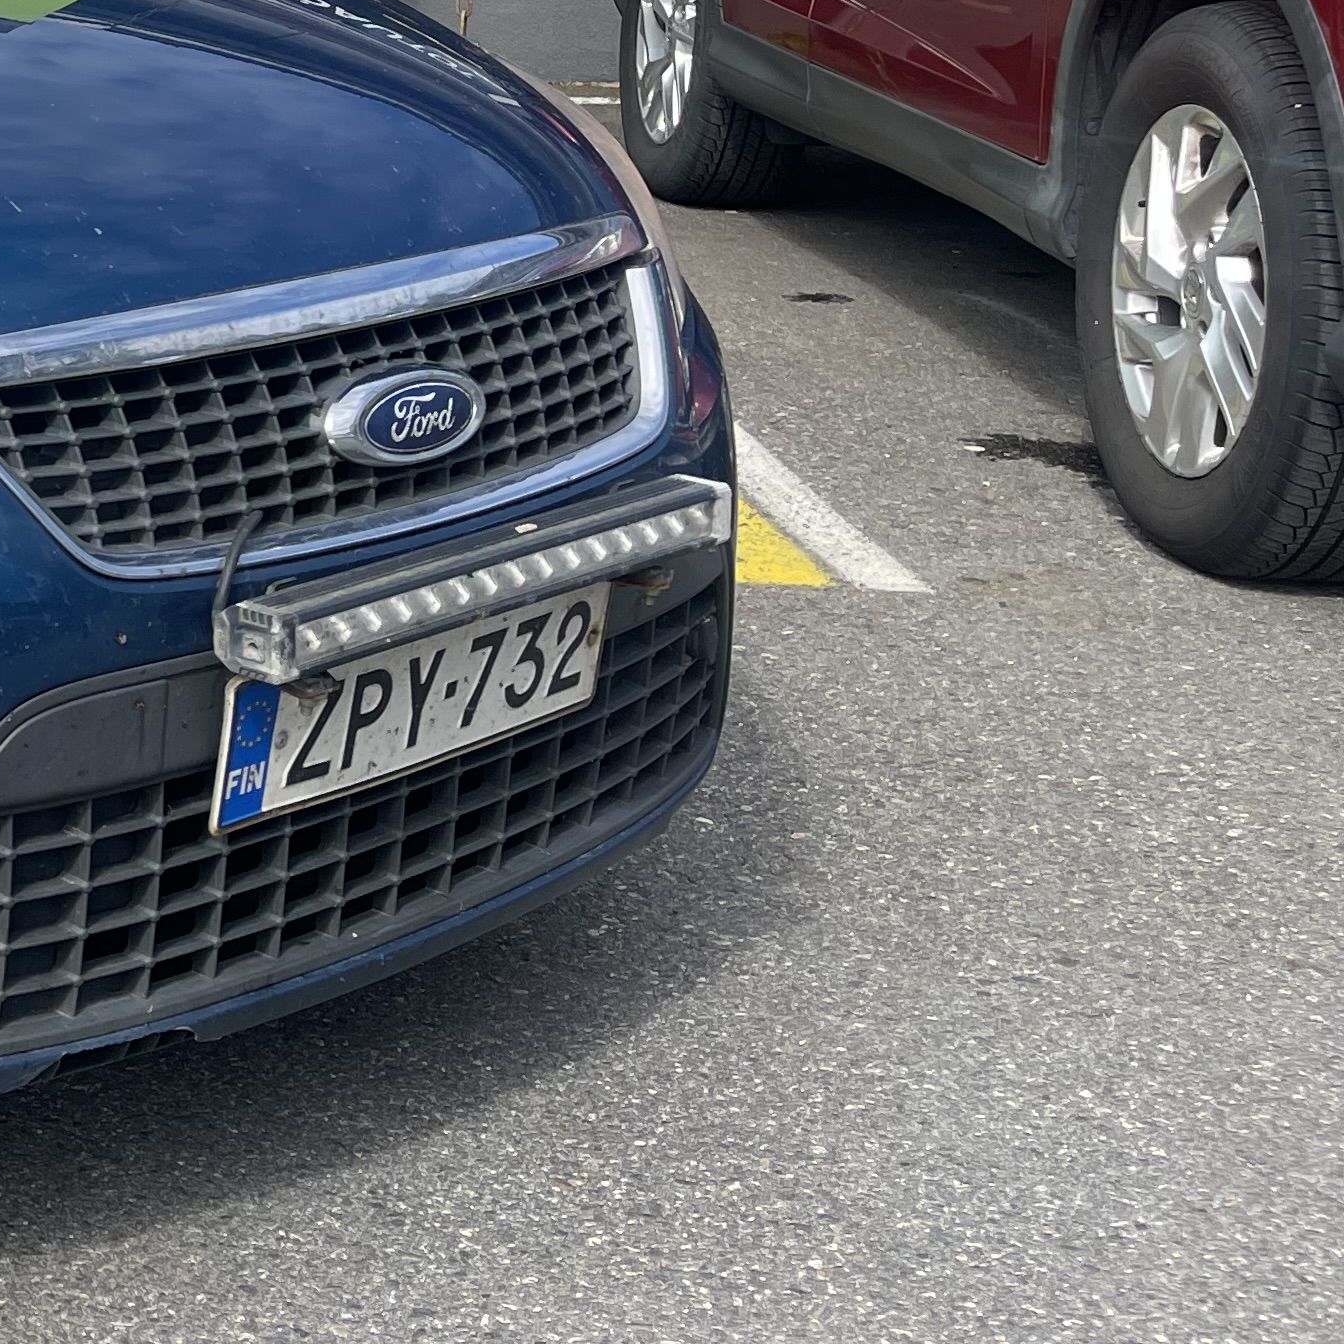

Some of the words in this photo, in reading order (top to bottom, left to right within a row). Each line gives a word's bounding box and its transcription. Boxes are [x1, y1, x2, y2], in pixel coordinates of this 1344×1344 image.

[390, 391, 456, 443] Ford
[283, 600, 592, 788] ZPY-732
[224, 760, 266, 801] FIN
